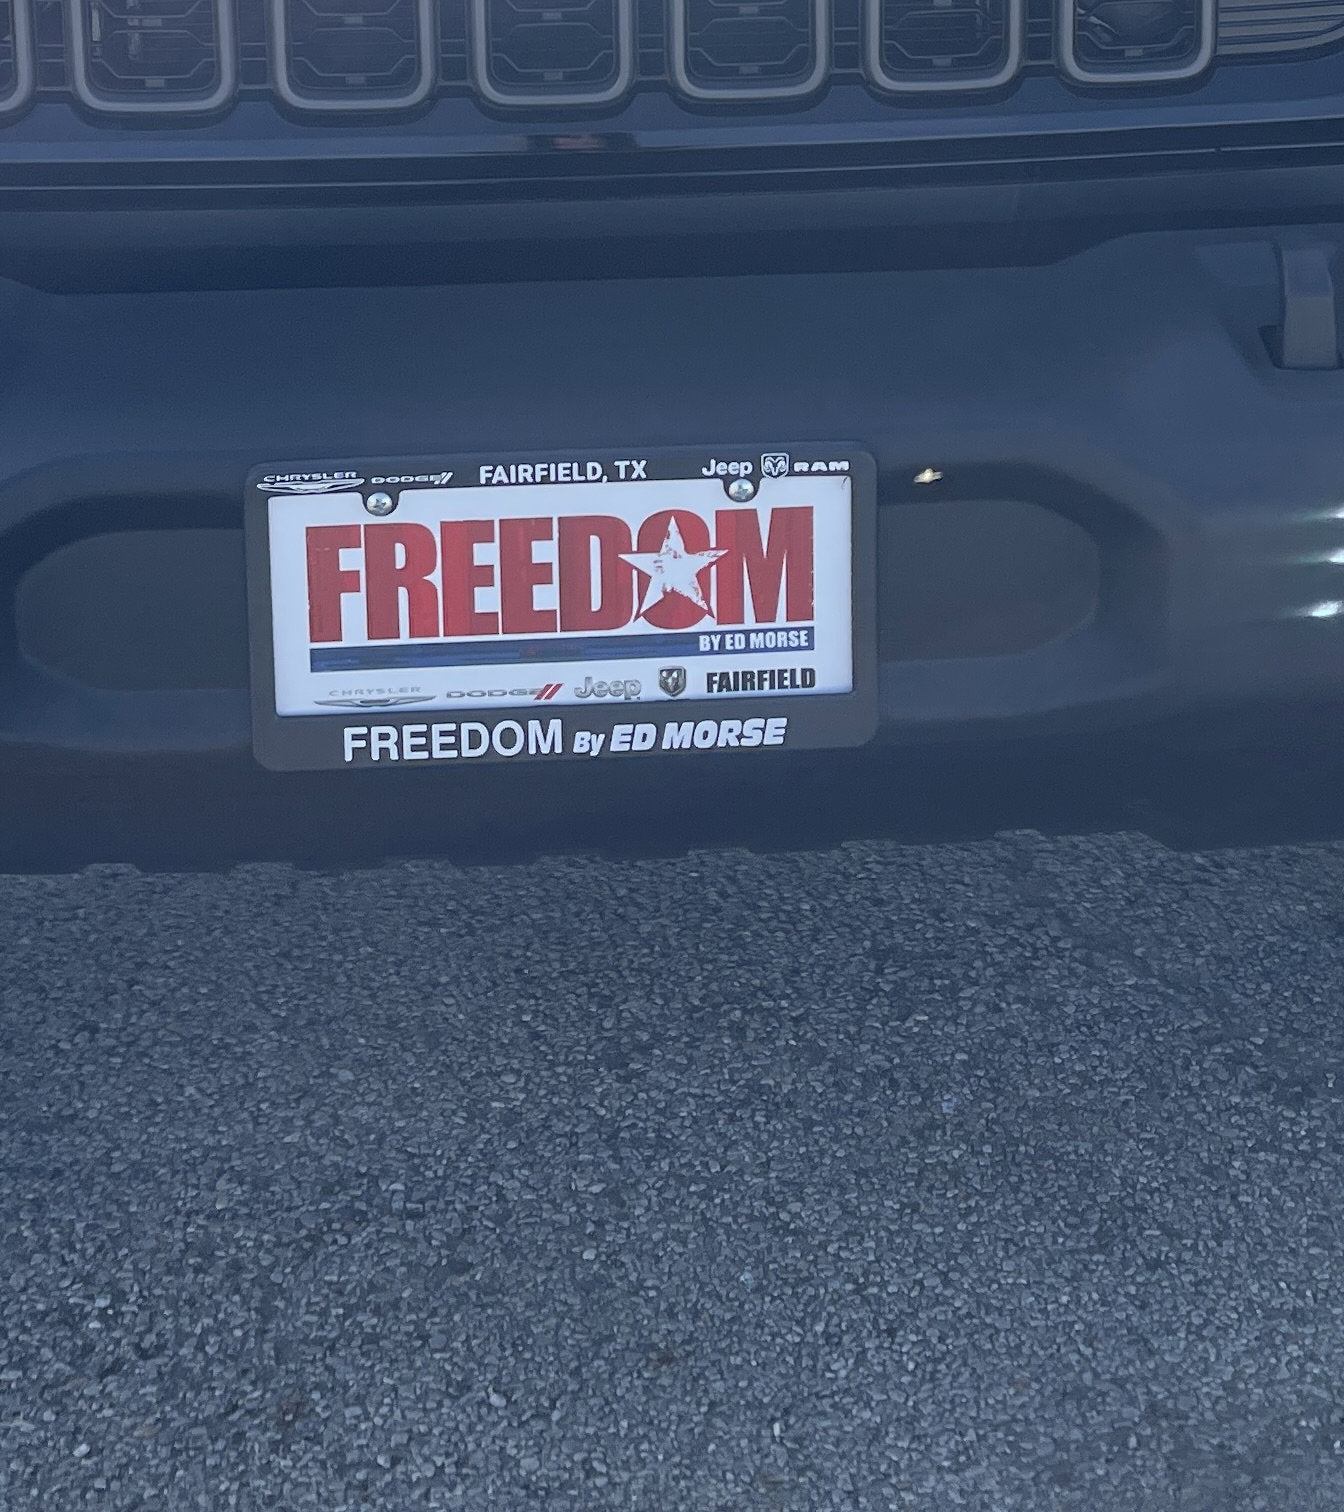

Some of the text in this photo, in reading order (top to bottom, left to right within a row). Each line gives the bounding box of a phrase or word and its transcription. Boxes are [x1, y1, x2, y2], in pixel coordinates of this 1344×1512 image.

[263, 471, 358, 483] CHRYSLER
[479, 459, 647, 484] FAIRFIELD, TX
[701, 458, 753, 477] Jeep
[793, 460, 850, 472] RAM
[305, 505, 815, 643] FREEDOM
[699, 630, 809, 651] BY ED MORSE
[575, 676, 641, 701] Jeep
[706, 668, 816, 693] FAIRFIELD
[343, 717, 788, 762] FREEDOM By ED MORSE
